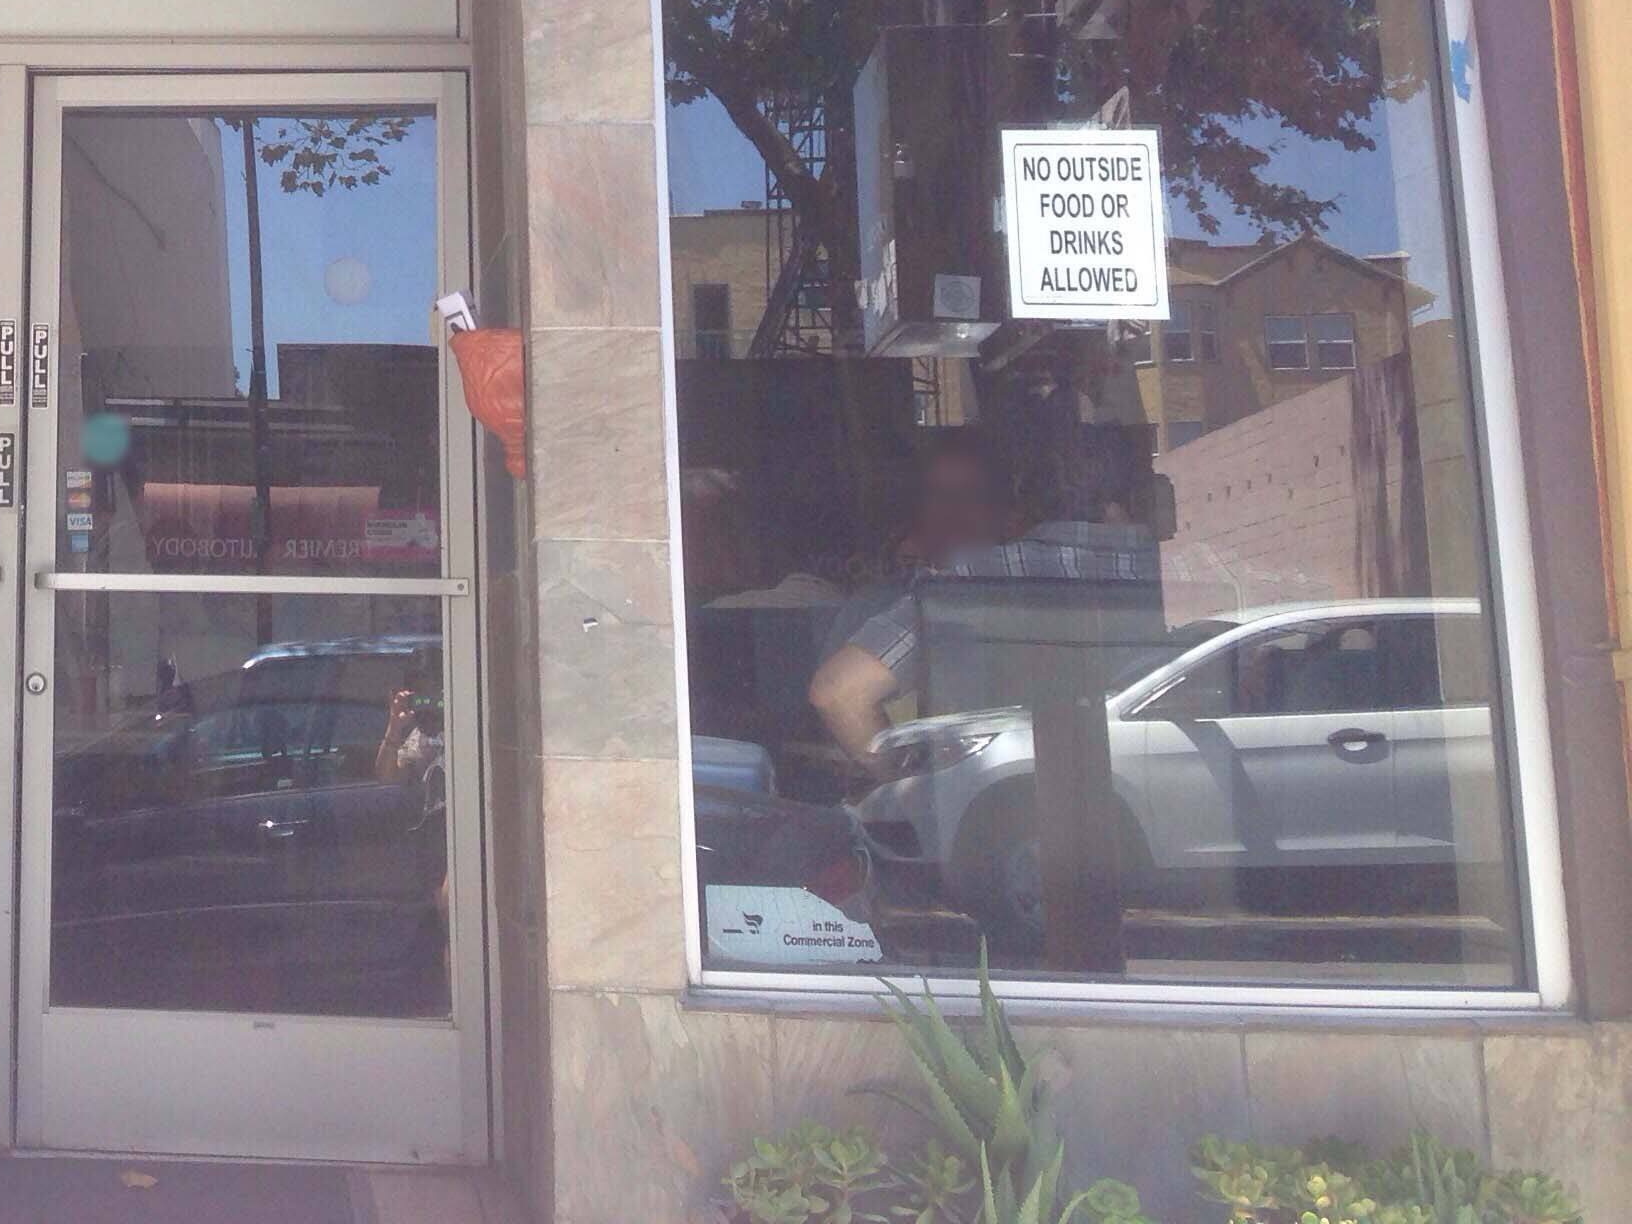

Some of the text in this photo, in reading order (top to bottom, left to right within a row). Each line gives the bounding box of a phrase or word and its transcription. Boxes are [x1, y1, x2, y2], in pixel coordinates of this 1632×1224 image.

[1022, 157, 1143, 181] NO OUTSIDE
[1040, 194, 1130, 218] FOOD OR
[1050, 231, 1123, 255] DRINKS
[1040, 267, 1138, 293] ALLOWED
[0, 326, 14, 385] PULL
[34, 330, 48, 388] PULL
[69, 517, 92, 526] VISA
[813, 920, 843, 933] in this
[783, 934, 875, 948] Commercial Zone
